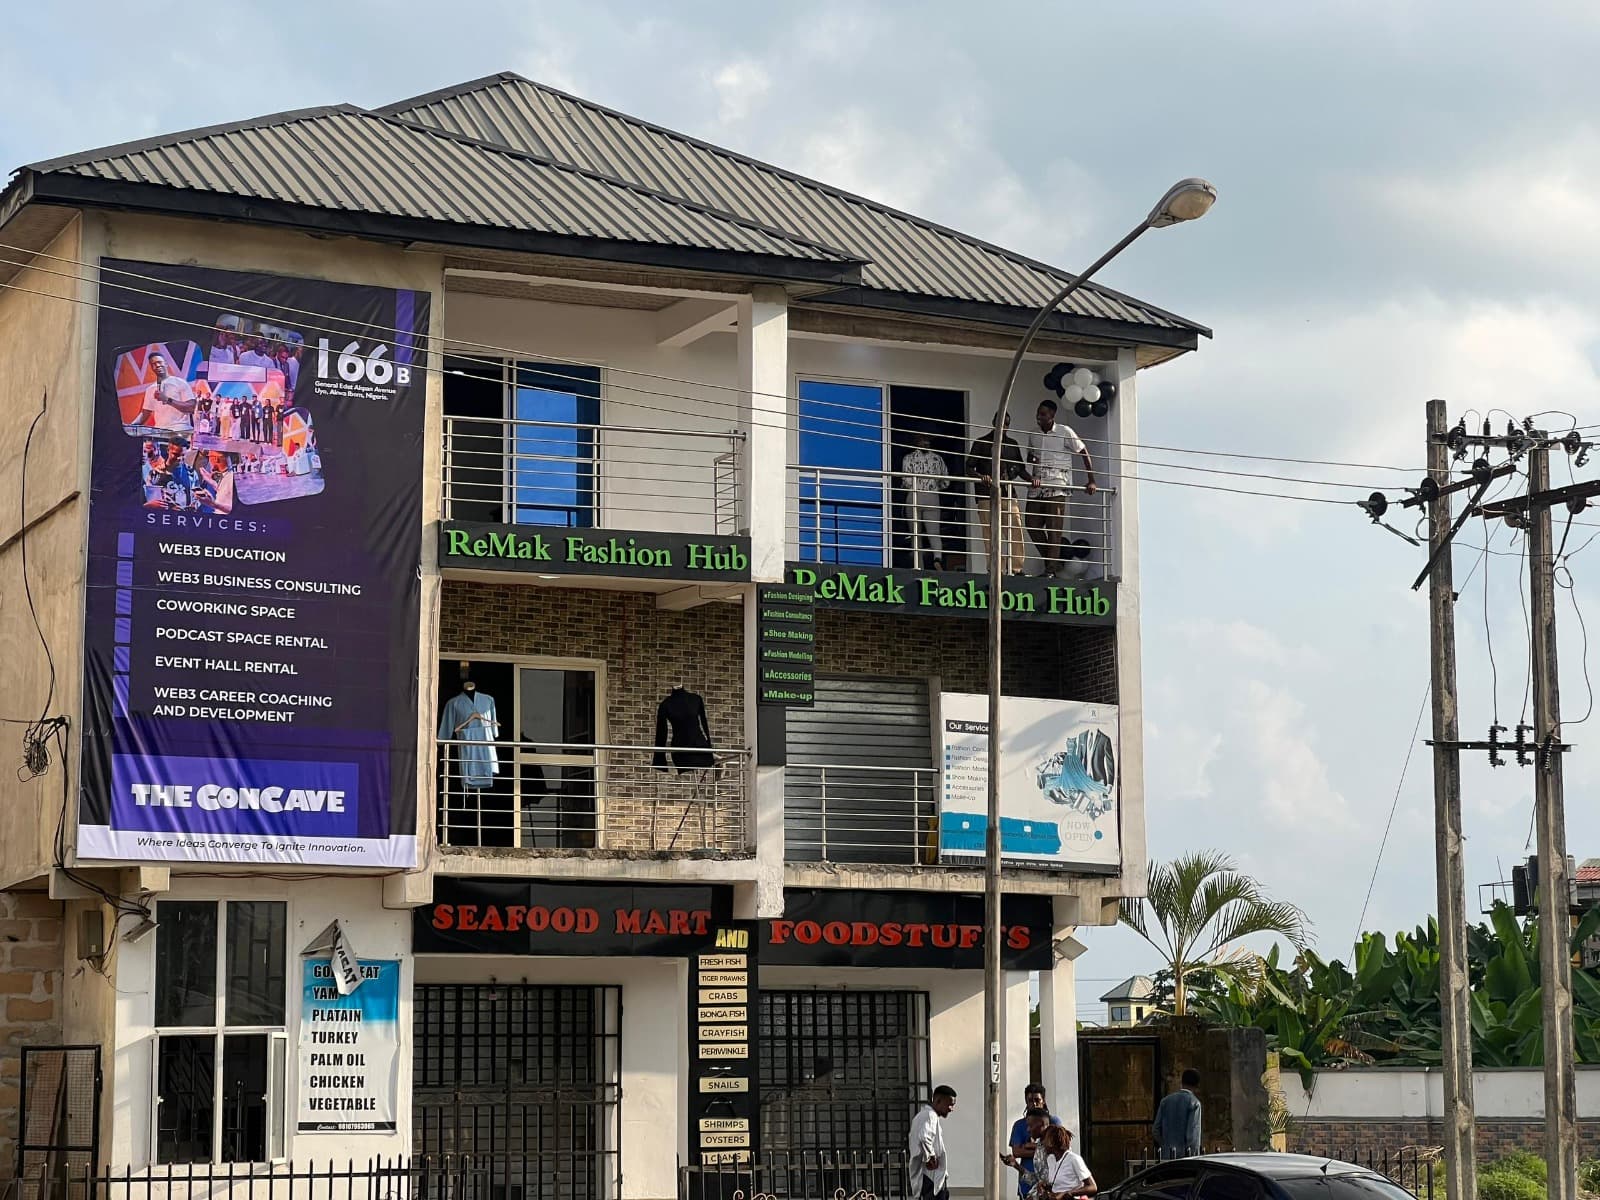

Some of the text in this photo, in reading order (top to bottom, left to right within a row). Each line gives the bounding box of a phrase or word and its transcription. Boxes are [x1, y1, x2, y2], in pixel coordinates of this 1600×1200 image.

[314, 380, 339, 390] General
[374, 386, 397, 395] Avenue
[146, 512, 267, 533] SERVICES:
[159, 542, 287, 563] WEB3 EDUCATION
[447, 529, 748, 571] ReMak Fashion Hub
[158, 570, 362, 596] WEB3 BUSINESS CONSULTING
[768, 591, 813, 602] Fashion Designing
[918, 576, 1036, 613] Fashon
[1047, 585, 1110, 616] Hub
[156, 599, 296, 619] COWORKING SPACE
[767, 609, 785, 618] Fashion
[156, 627, 329, 649] PODCAST SPACE RENTAL
[768, 629, 813, 641] Shoe Making
[768, 649, 787, 659] Fashion
[155, 655, 299, 675] EVENT HALL RENTAL
[769, 669, 812, 681] Accessories
[154, 686, 333, 709] WEB3 CAREER COACHING
[768, 690, 813, 702] Make-up
[153, 704, 296, 723] AND DEVELOPMENT
[949, 722, 989, 732] Our Service
[131, 783, 193, 808] THE
[137, 837, 367, 854] Where Ideas Converge To Ignite Innovation.
[432, 904, 711, 935] SEAFOOD MART
[715, 929, 748, 949] AND
[769, 920, 1030, 950] FOODSTUFS
[312, 1010, 361, 1022] PLATAIN
[701, 1010, 745, 1019] BONGA FISH
[312, 1031, 358, 1044] TURKEY
[310, 1053, 365, 1066] PALM OIL
[310, 1075, 364, 1088] CHICKEN
[709, 1081, 740, 1089] SNAILS
[309, 1097, 376, 1111] VEGETABLE
[705, 1121, 744, 1129] SHRIMPS
[706, 1136, 745, 1144] OYSTERS
